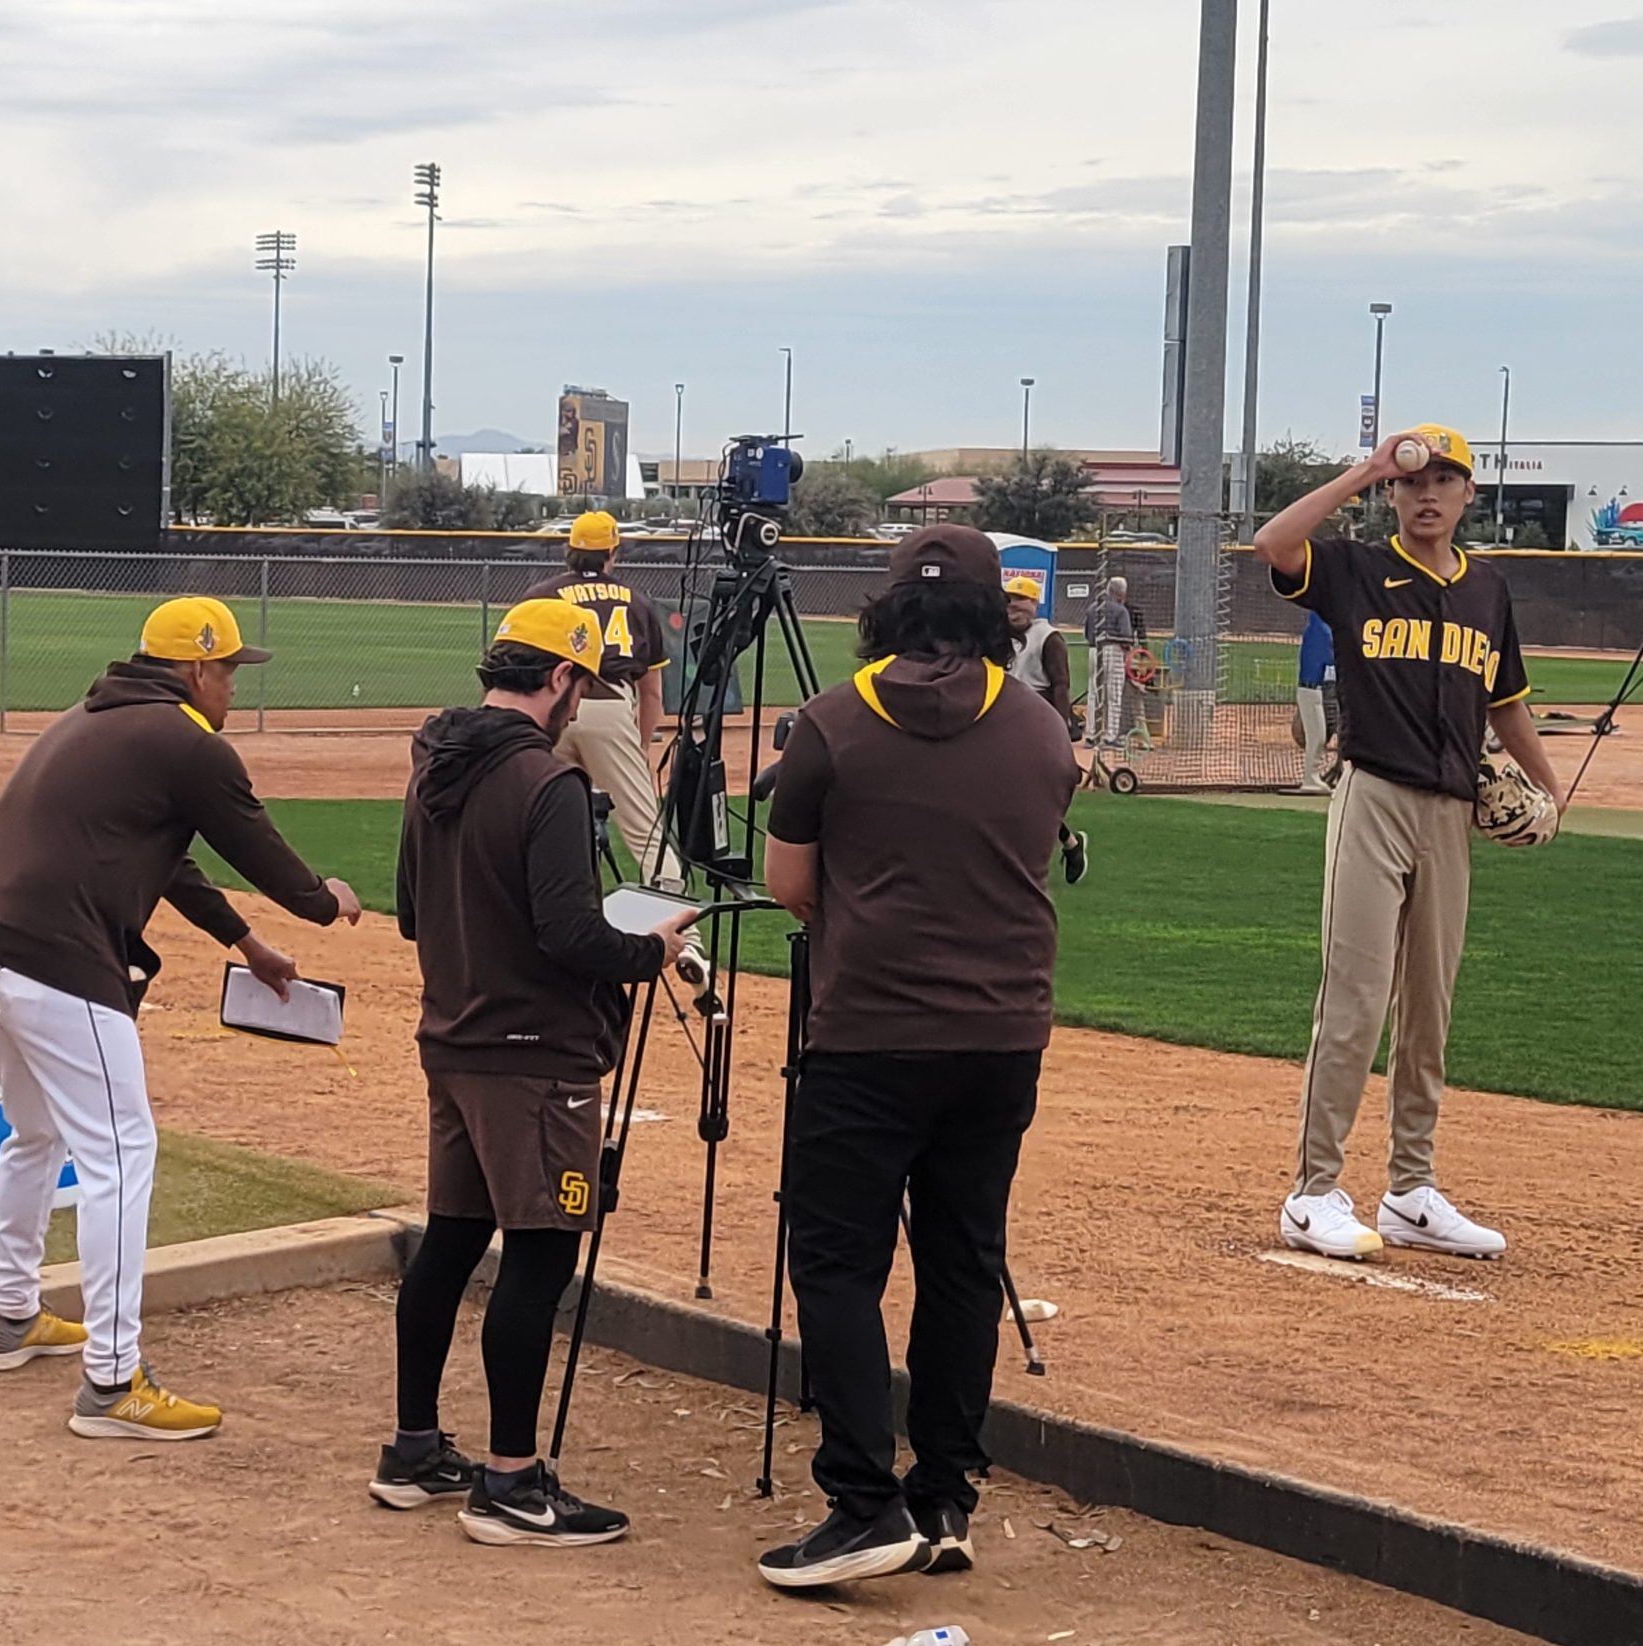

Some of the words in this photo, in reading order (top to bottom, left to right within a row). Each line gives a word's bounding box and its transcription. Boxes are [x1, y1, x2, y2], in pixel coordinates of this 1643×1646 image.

[1509, 461, 1542, 470] ITALIA
[557, 583, 632, 603] WATSON
[1362, 618, 1432, 660] SAN
[559, 1171, 589, 1215] SD
